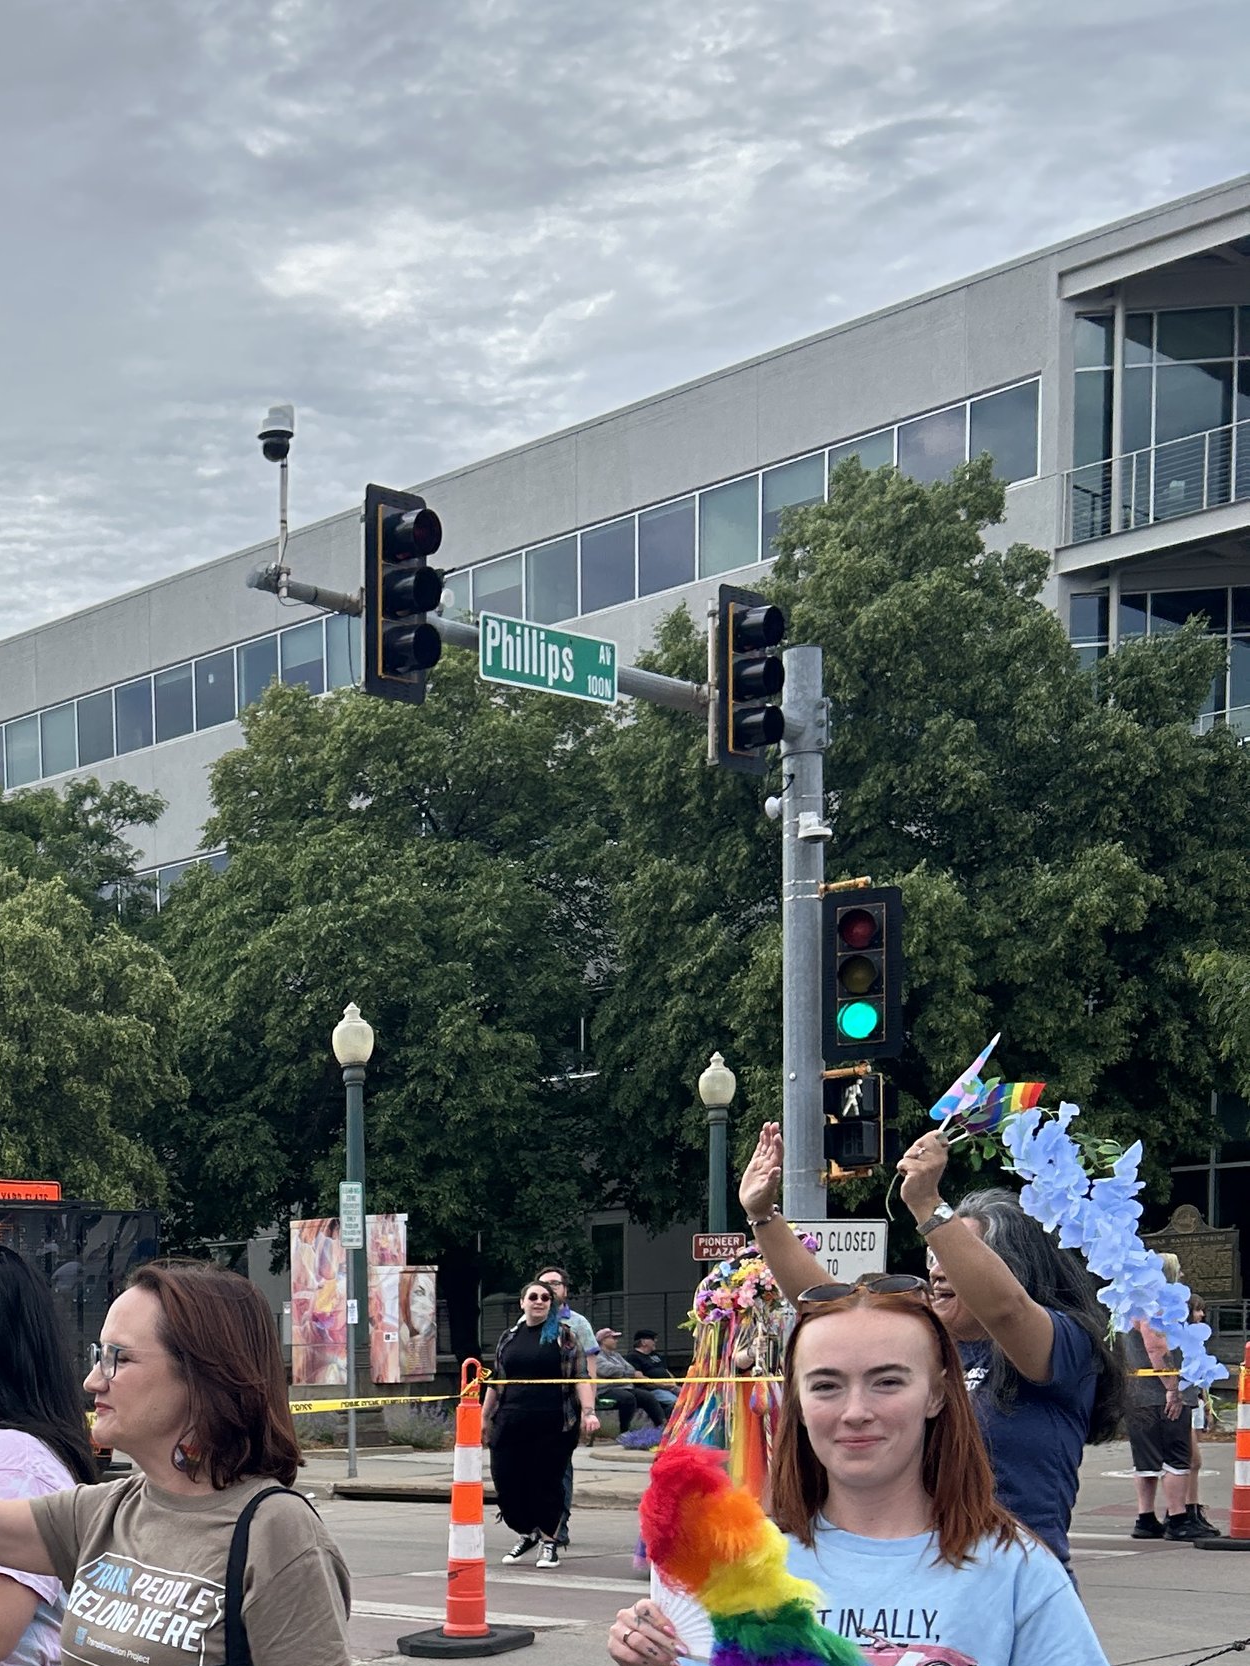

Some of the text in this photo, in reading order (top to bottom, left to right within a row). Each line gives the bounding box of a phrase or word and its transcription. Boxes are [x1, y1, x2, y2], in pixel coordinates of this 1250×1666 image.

[486, 618, 612, 687] Phillips AV
[587, 674, 612, 699] 100N
[698, 1236, 740, 1247] PIONEER
[702, 1246, 735, 1257] PLAZA
[828, 1231, 877, 1252] CLOSED
[827, 1259, 839, 1276] TO
[131, 1572, 215, 1616] PEOPLE
[66, 1579, 209, 1653] BELONG HERE
[838, 1608, 864, 1638] IN
[86, 1636, 127, 1658] Transformation
[126, 1649, 150, 1665] Project
